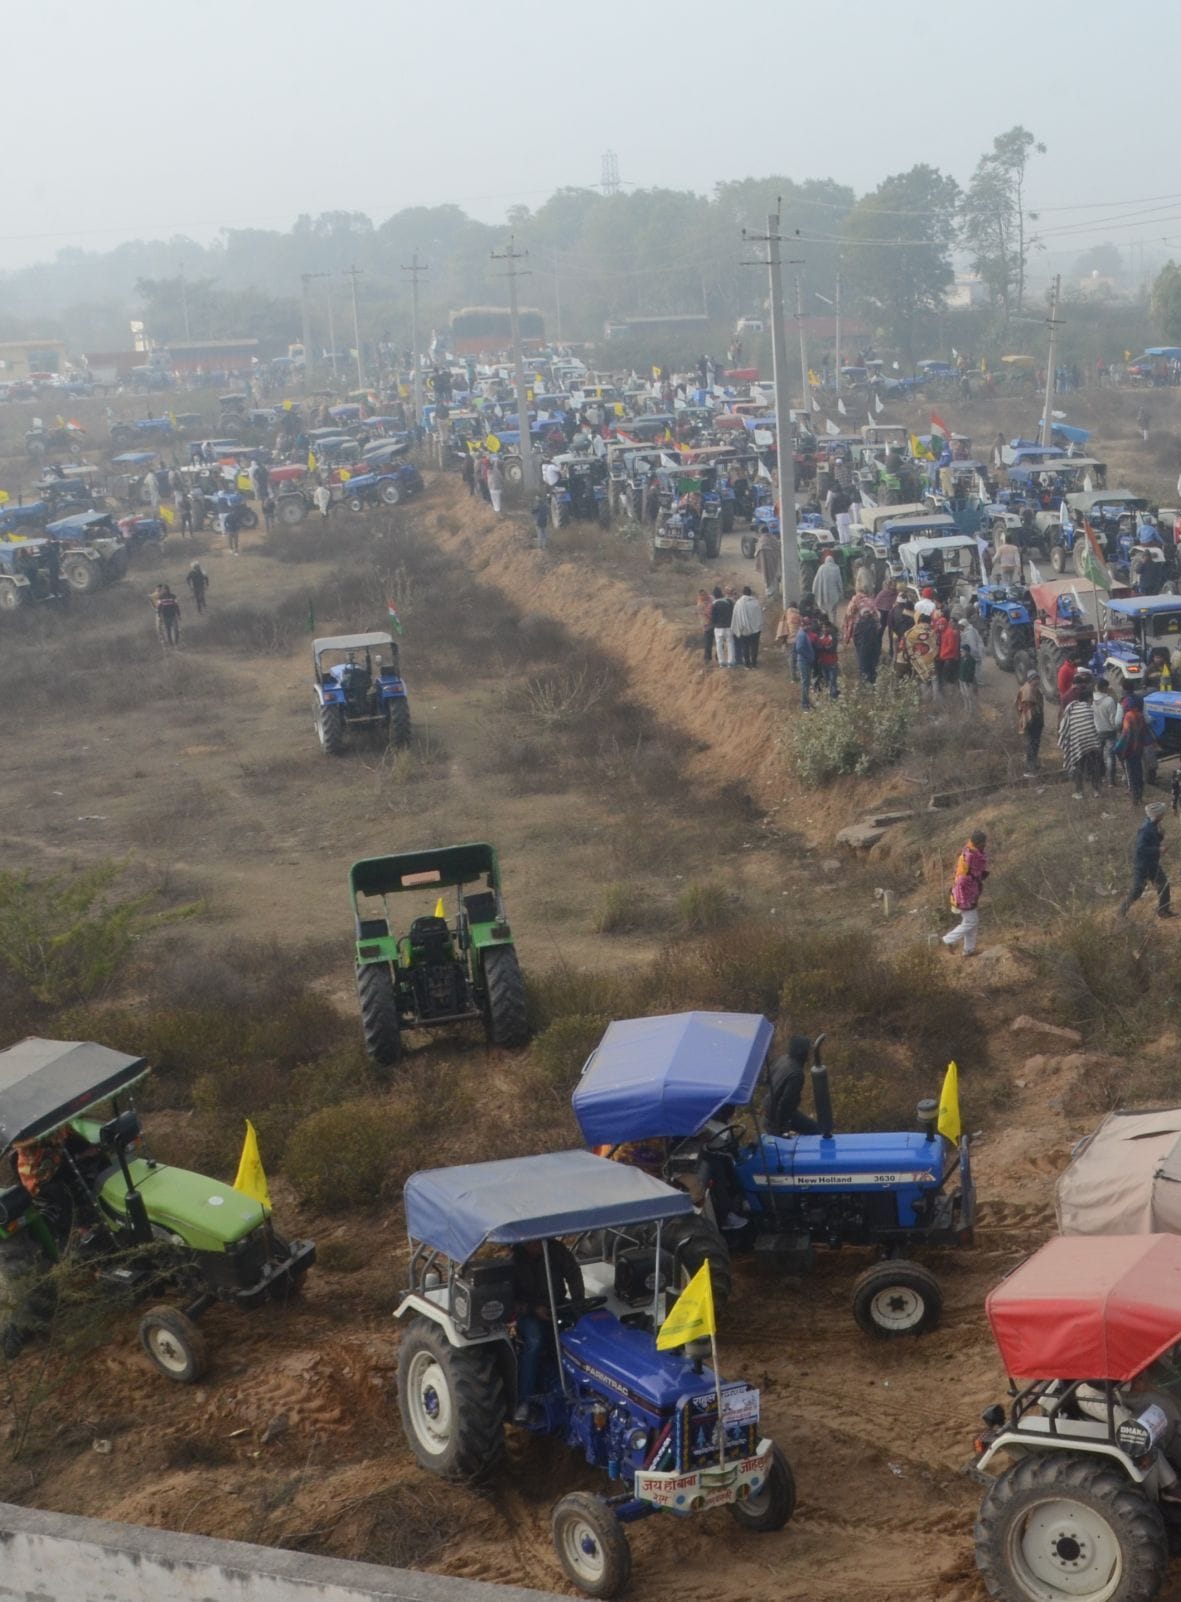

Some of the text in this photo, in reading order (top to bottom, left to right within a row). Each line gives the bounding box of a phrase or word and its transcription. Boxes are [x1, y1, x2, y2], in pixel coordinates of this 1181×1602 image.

[819, 1176, 852, 1184] Holland
[585, 1364, 629, 1396] FARMTRAC
[1120, 1425, 1148, 1436] DHAKA
